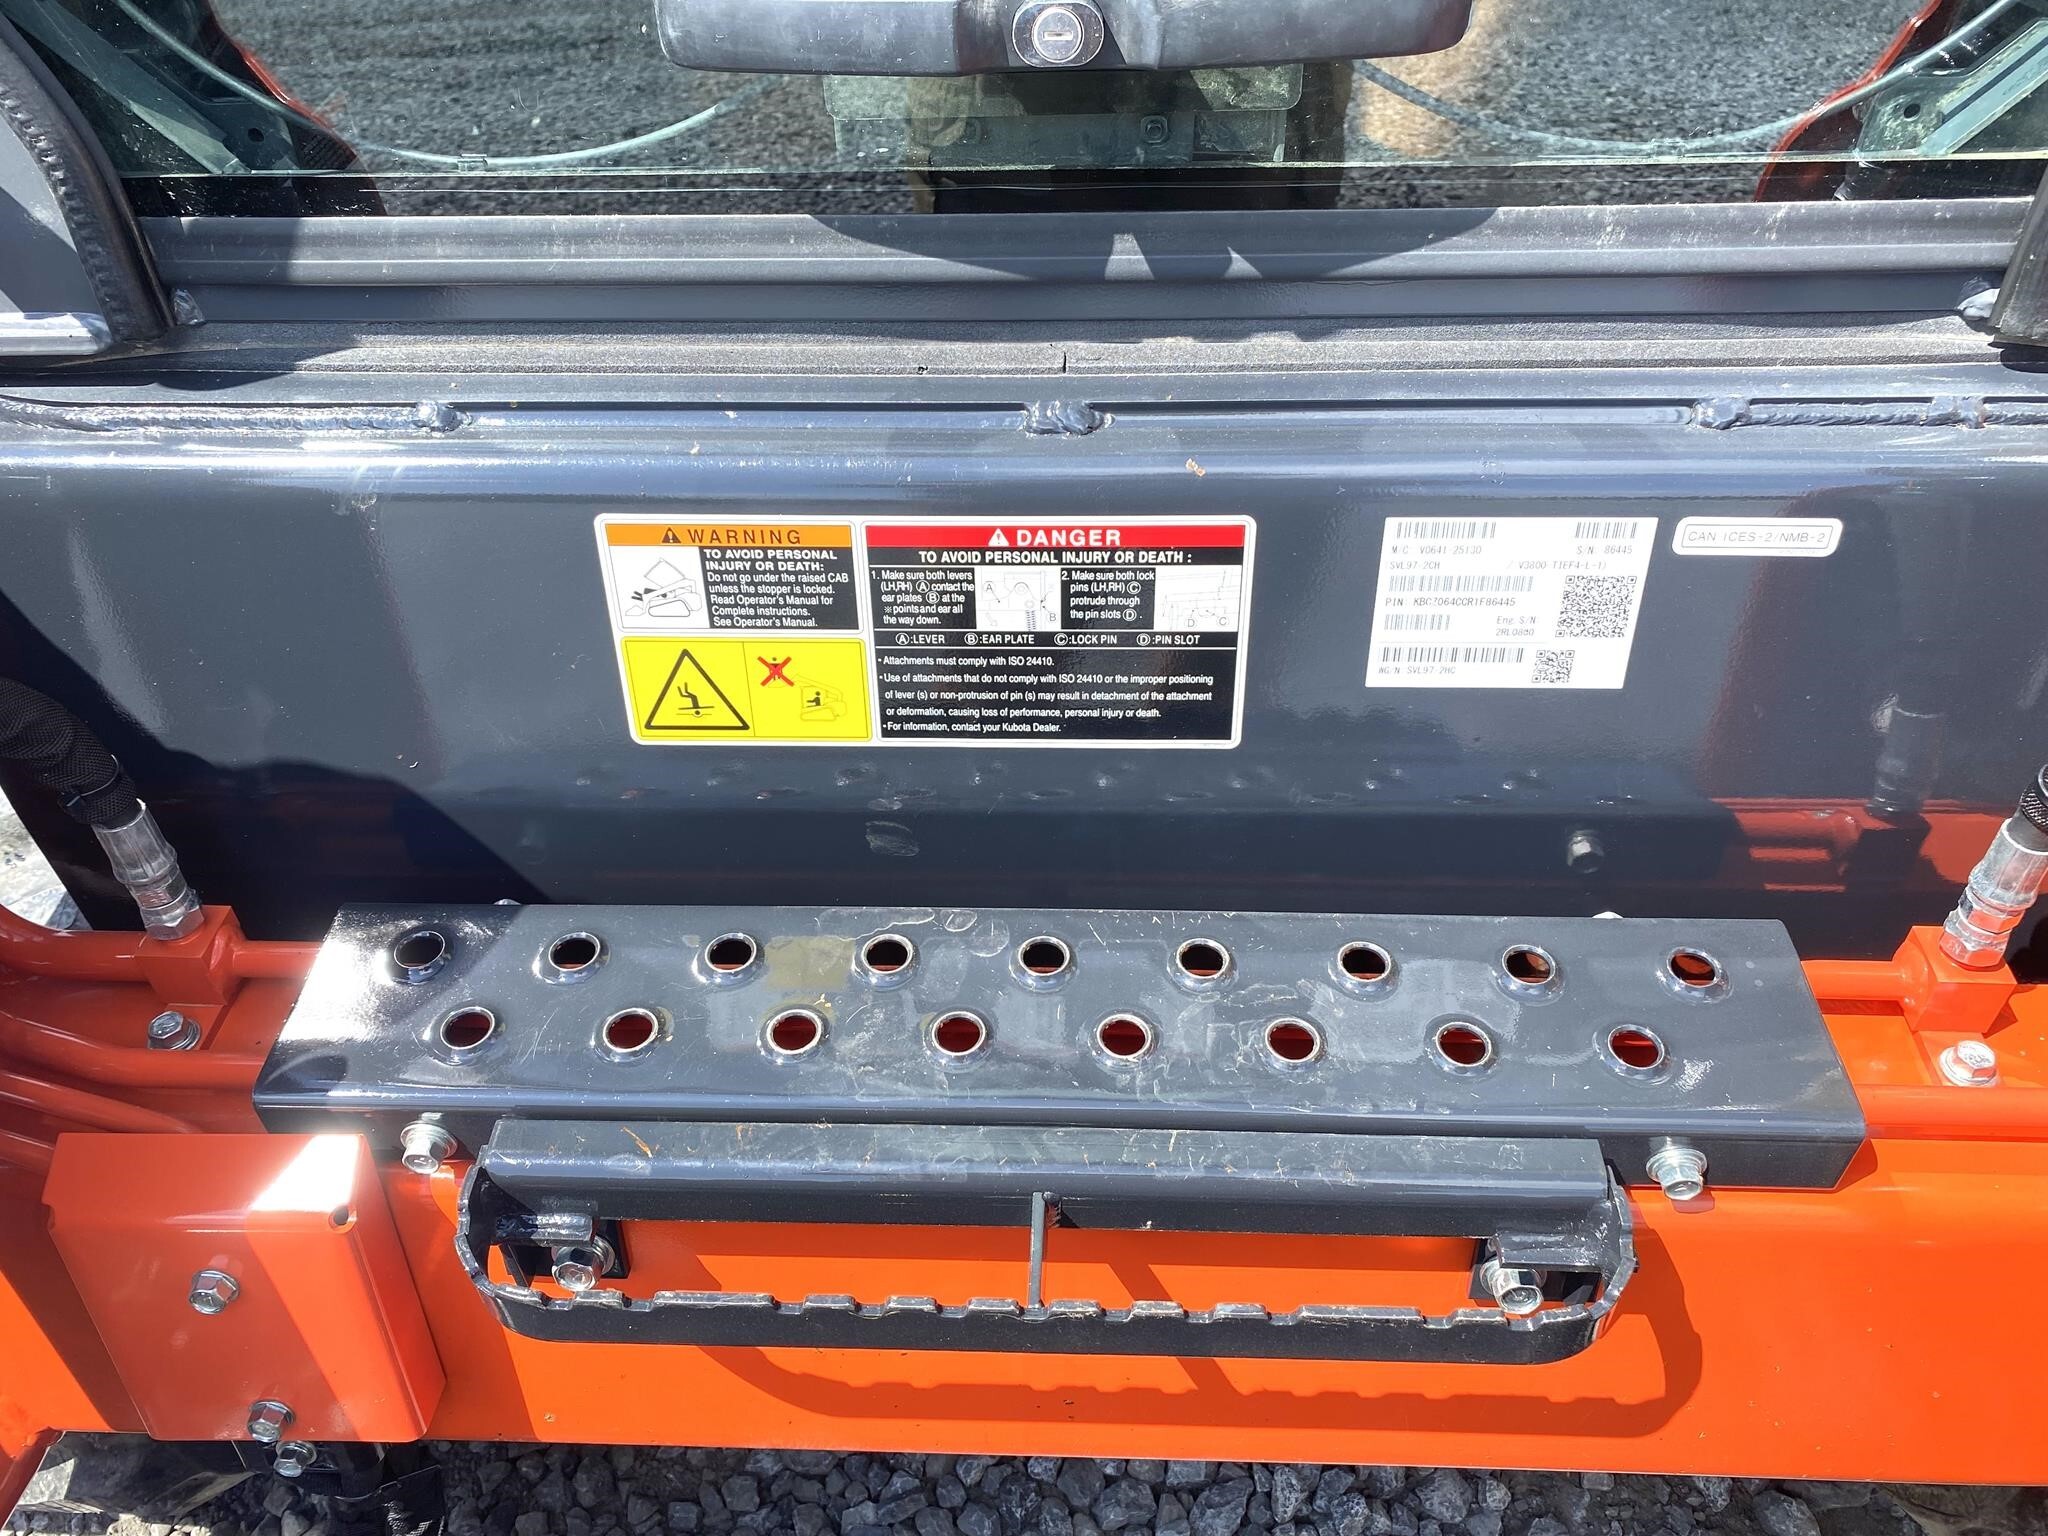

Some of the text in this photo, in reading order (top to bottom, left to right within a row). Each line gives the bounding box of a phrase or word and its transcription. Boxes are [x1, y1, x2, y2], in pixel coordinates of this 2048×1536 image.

[688, 529, 801, 544] WARNING
[1017, 529, 1120, 546] DANGER
[1688, 531, 1716, 541] CAN
[703, 549, 838, 559] TO AVOID PERSONAL
[1604, 545, 1632, 554] 86445
[918, 551, 937, 563] TO
[941, 551, 982, 563] AVOID
[985, 551, 1058, 563] PERSONAL
[1062, 552, 1111, 563] INJURY
[1114, 552, 1134, 563] OR
[1138, 551, 1183, 563] DEATH
[706, 561, 824, 571] INJURY OR DEATH:
[708, 572, 849, 586] Do not go under the raised CAB
[872, 570, 972, 581] 1. Make sure both levers
[1062, 570, 1155, 580] 2. Make sure both lock
[709, 584, 835, 596] unless the stopper is locked.
[881, 582, 912, 592] (LH,RH)
[930, 583, 961, 592] contact
[961, 582, 975, 591] the
[1070, 582, 1089, 593] pins
[1090, 582, 1126, 593] (LH,RH)
[710, 595, 833, 606] Read Operator's Manual for
[896, 594, 923, 605] plates
[941, 594, 951, 602] at
[951, 594, 965, 602] the
[1070, 596, 1140, 607] protrude through
[712, 606, 811, 618] Complete instructions.
[893, 605, 920, 615] points
[952, 605, 963, 613] all
[1070, 610, 1084, 618] the
[1085, 610, 1099, 620] pin
[1100, 610, 1121, 619] slots
[714, 617, 818, 628] See Operator's Manual.
[883, 616, 941, 626] the way down.
[1004, 634, 1035, 644] PLATE
[1101, 635, 1117, 644] PIN
[1174, 635, 1200, 645] SLOT
[883, 656, 1054, 667] Attachments must comply with ISO 24410.
[883, 673, 901, 683] Use
[902, 673, 910, 683] of
[912, 673, 962, 683] attachments
[964, 673, 979, 683] that
[981, 673, 992, 683] do
[994, 674, 1007, 683] not
[1008, 673, 1038, 684] comply
[1040, 673, 1057, 683] with
[1059, 674, 1075, 683] ISO
[1077, 674, 1103, 683] 24410
[1115, 674, 1128, 683] the
[1130, 674, 1167, 685] improper
[1169, 674, 1213, 686] positioning
[917, 691, 928, 700] (s)
[940, 691, 998, 701] non-protrusion
[1000, 691, 1008, 700] of
[1010, 691, 1023, 701] pin
[1025, 691, 1035, 701] (s)
[1038, 693, 1055, 702] may
[896, 708, 946, 716] deformation,
[948, 708, 980, 718] causing
[981, 708, 998, 716] loss
[999, 708, 1008, 716] of
[1009, 708, 1063, 718] performance,
[1065, 709, 1100, 718] personal
[1102, 709, 1124, 719] injury
[1136, 709, 1162, 717] death.
[888, 722, 1061, 733] For information, contact your Kubota Dealer.
